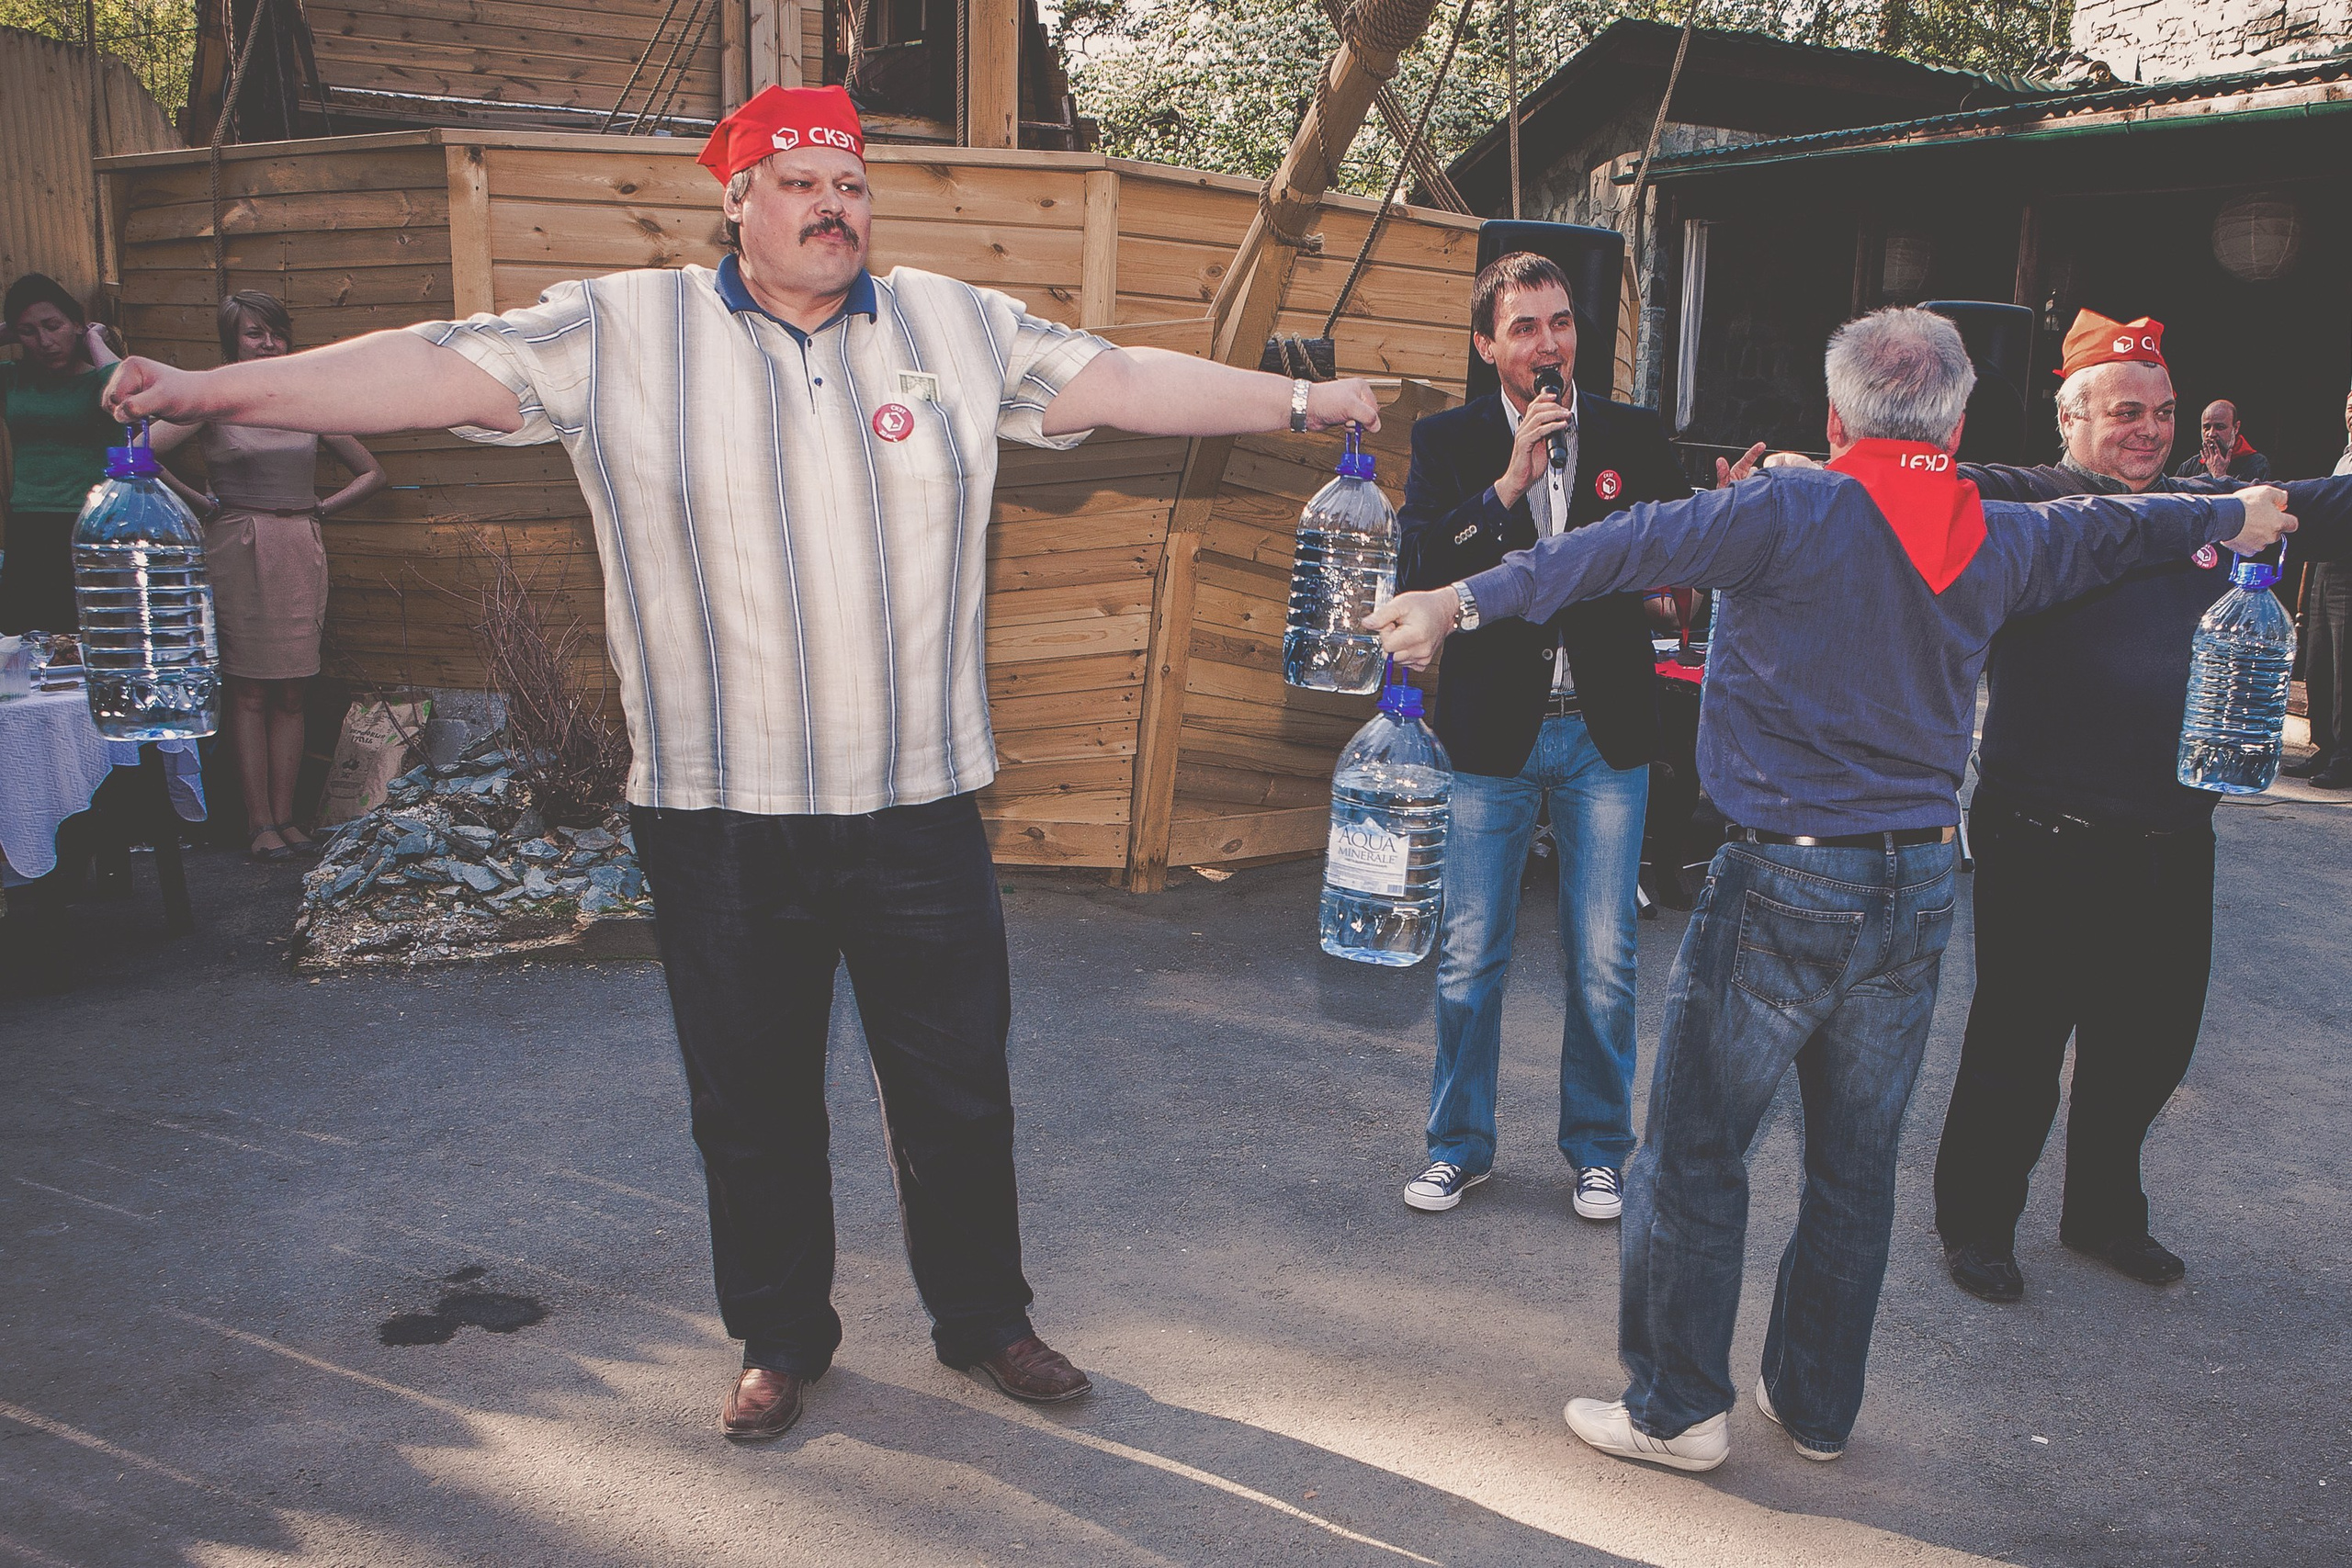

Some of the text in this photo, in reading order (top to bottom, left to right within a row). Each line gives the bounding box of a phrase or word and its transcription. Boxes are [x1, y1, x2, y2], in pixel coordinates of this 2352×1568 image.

[808, 127, 856, 152] СКЭТ
[1338, 826, 1397, 853] AQUA
[1338, 846, 1396, 864] MINERALE
